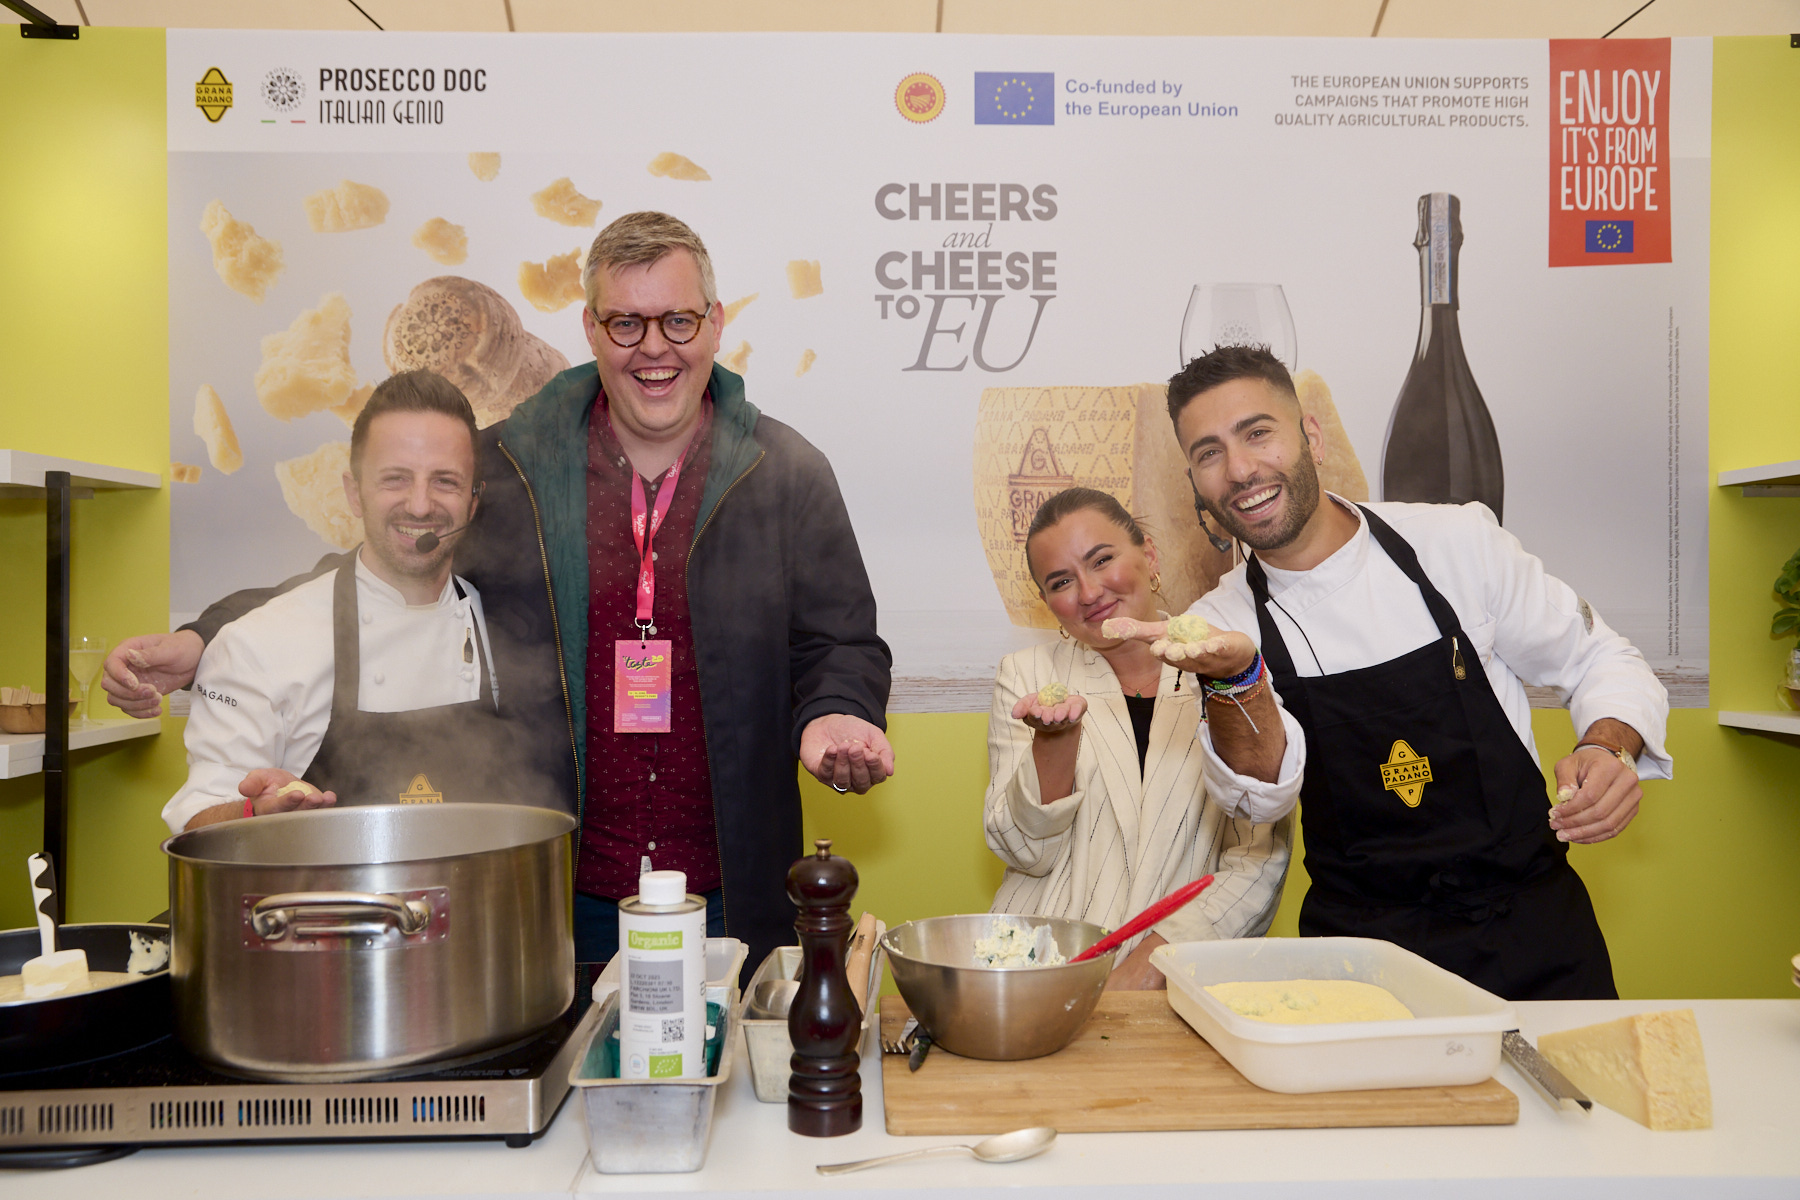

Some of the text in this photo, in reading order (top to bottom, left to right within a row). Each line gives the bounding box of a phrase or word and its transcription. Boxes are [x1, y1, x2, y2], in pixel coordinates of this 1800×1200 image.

[319, 68, 487, 92] PROSECCO DOC
[1065, 79, 1183, 98] Co-funded by
[1291, 75, 1529, 90] THE EUROPEAN UNION SUPPORTS
[1295, 94, 1529, 109] CAMPAIGNS THAT PROMOTE HIGH
[1559, 68, 1661, 126] ENJOY
[319, 99, 444, 125] ITALIAN GENIO
[1065, 101, 1239, 119] the European Union
[1274, 113, 1529, 128] QUALITY AGRICULTURAL PRODUCTS.
[1562, 127, 1657, 165] IT'S FROM
[1560, 165, 1659, 211] EUROPE
[874, 182, 1058, 221] CHEERS
[942, 222, 993, 249] and
[874, 250, 1057, 291] CHEESE
[874, 293, 1057, 373] TO EU
[1078, 409, 1131, 422] GRANA
[1398, 751, 1406, 759] G
[1383, 763, 1428, 777] GRANA
[1384, 770, 1430, 784] PADANO
[416, 783, 424, 791] G
[1408, 788, 1414, 796] P
[630, 931, 680, 949] Organic
